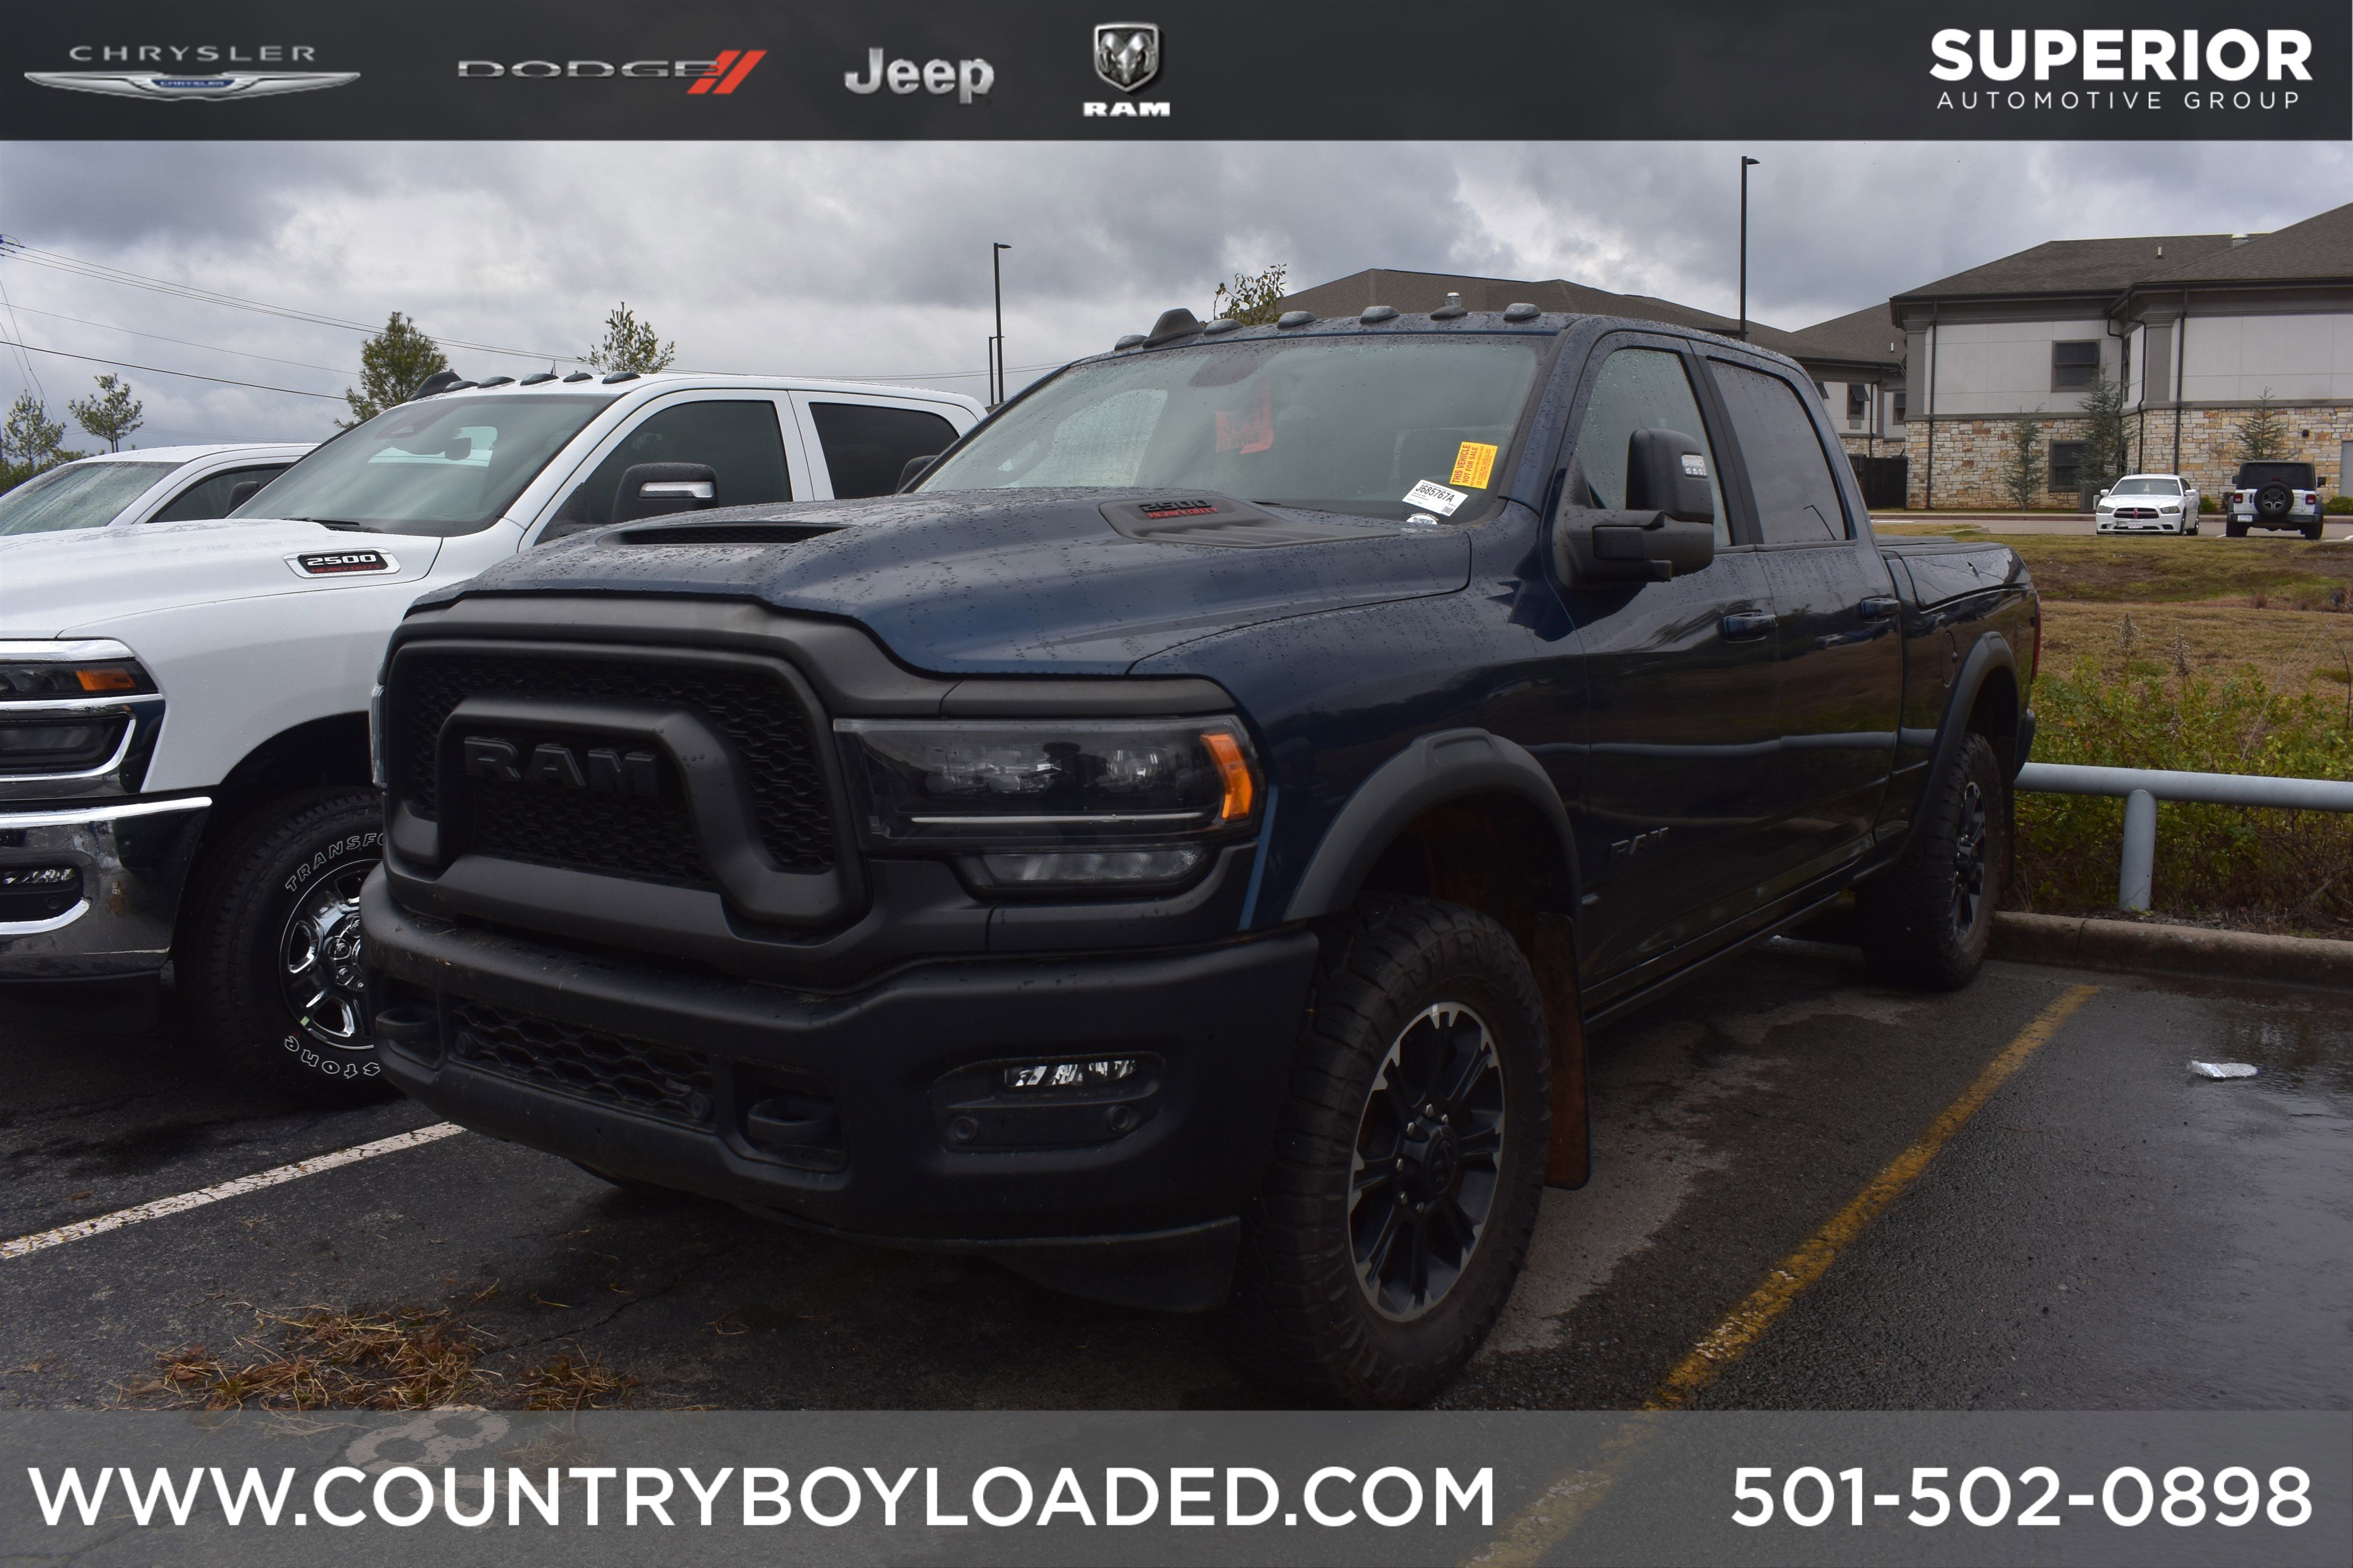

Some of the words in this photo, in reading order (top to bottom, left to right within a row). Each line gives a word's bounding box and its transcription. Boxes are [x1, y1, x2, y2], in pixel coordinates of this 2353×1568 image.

[1456, 444, 1470, 469] VEHICLE
[1468, 446, 1478, 459] SALE
[1465, 461, 1474, 471] FOR
[1452, 469, 1463, 484] THIS
[1461, 472, 1471, 483] NOT
[1415, 484, 1455, 503] J685767A
[1139, 500, 1212, 513] 2500
[1148, 510, 1186, 519] HEAVY
[1187, 507, 1218, 516] DUTY
[306, 554, 377, 566] 2500
[464, 736, 658, 797] RAM
